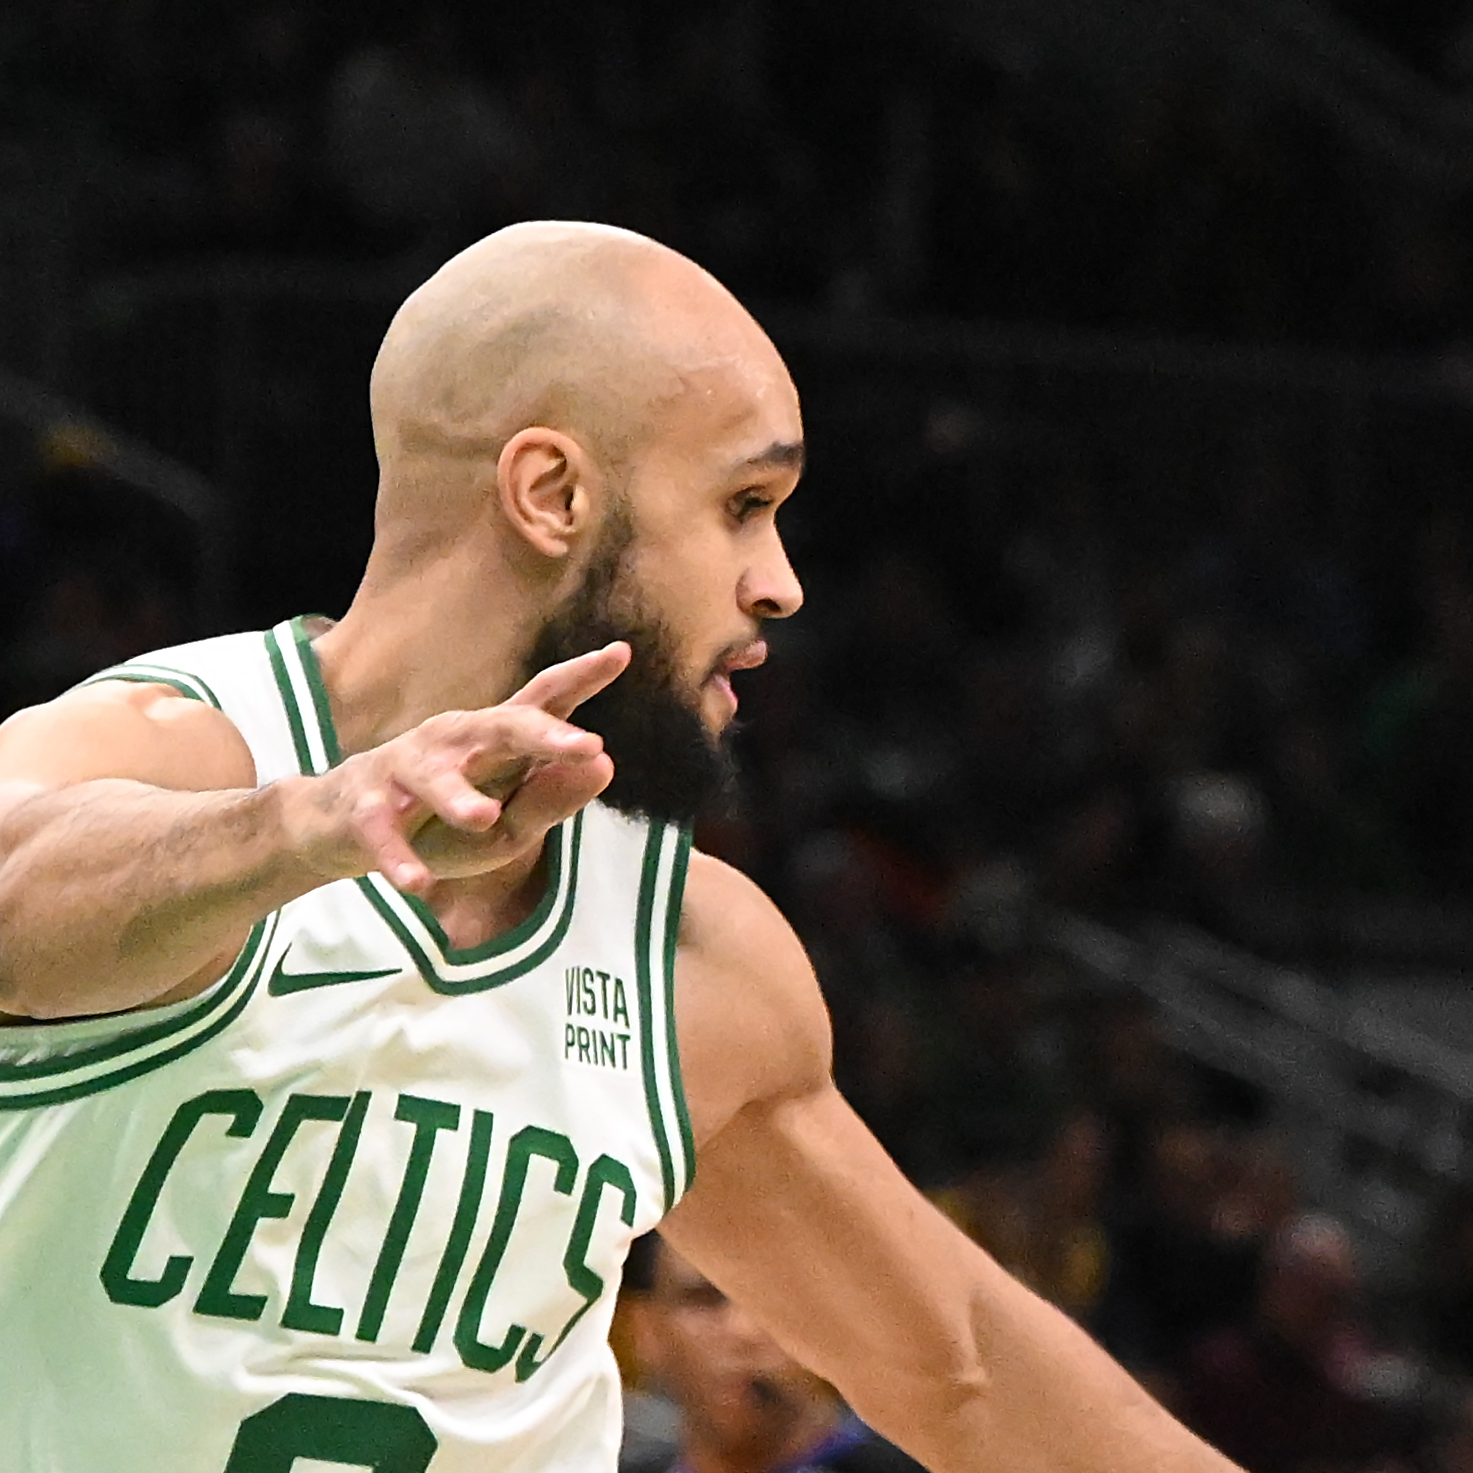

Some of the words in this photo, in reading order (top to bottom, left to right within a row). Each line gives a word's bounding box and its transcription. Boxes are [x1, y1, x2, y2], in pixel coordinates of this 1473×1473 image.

[565, 964, 630, 1029] VISTA
[564, 1022, 631, 1070] PRINT
[99, 1088, 637, 1384] CELTICS
